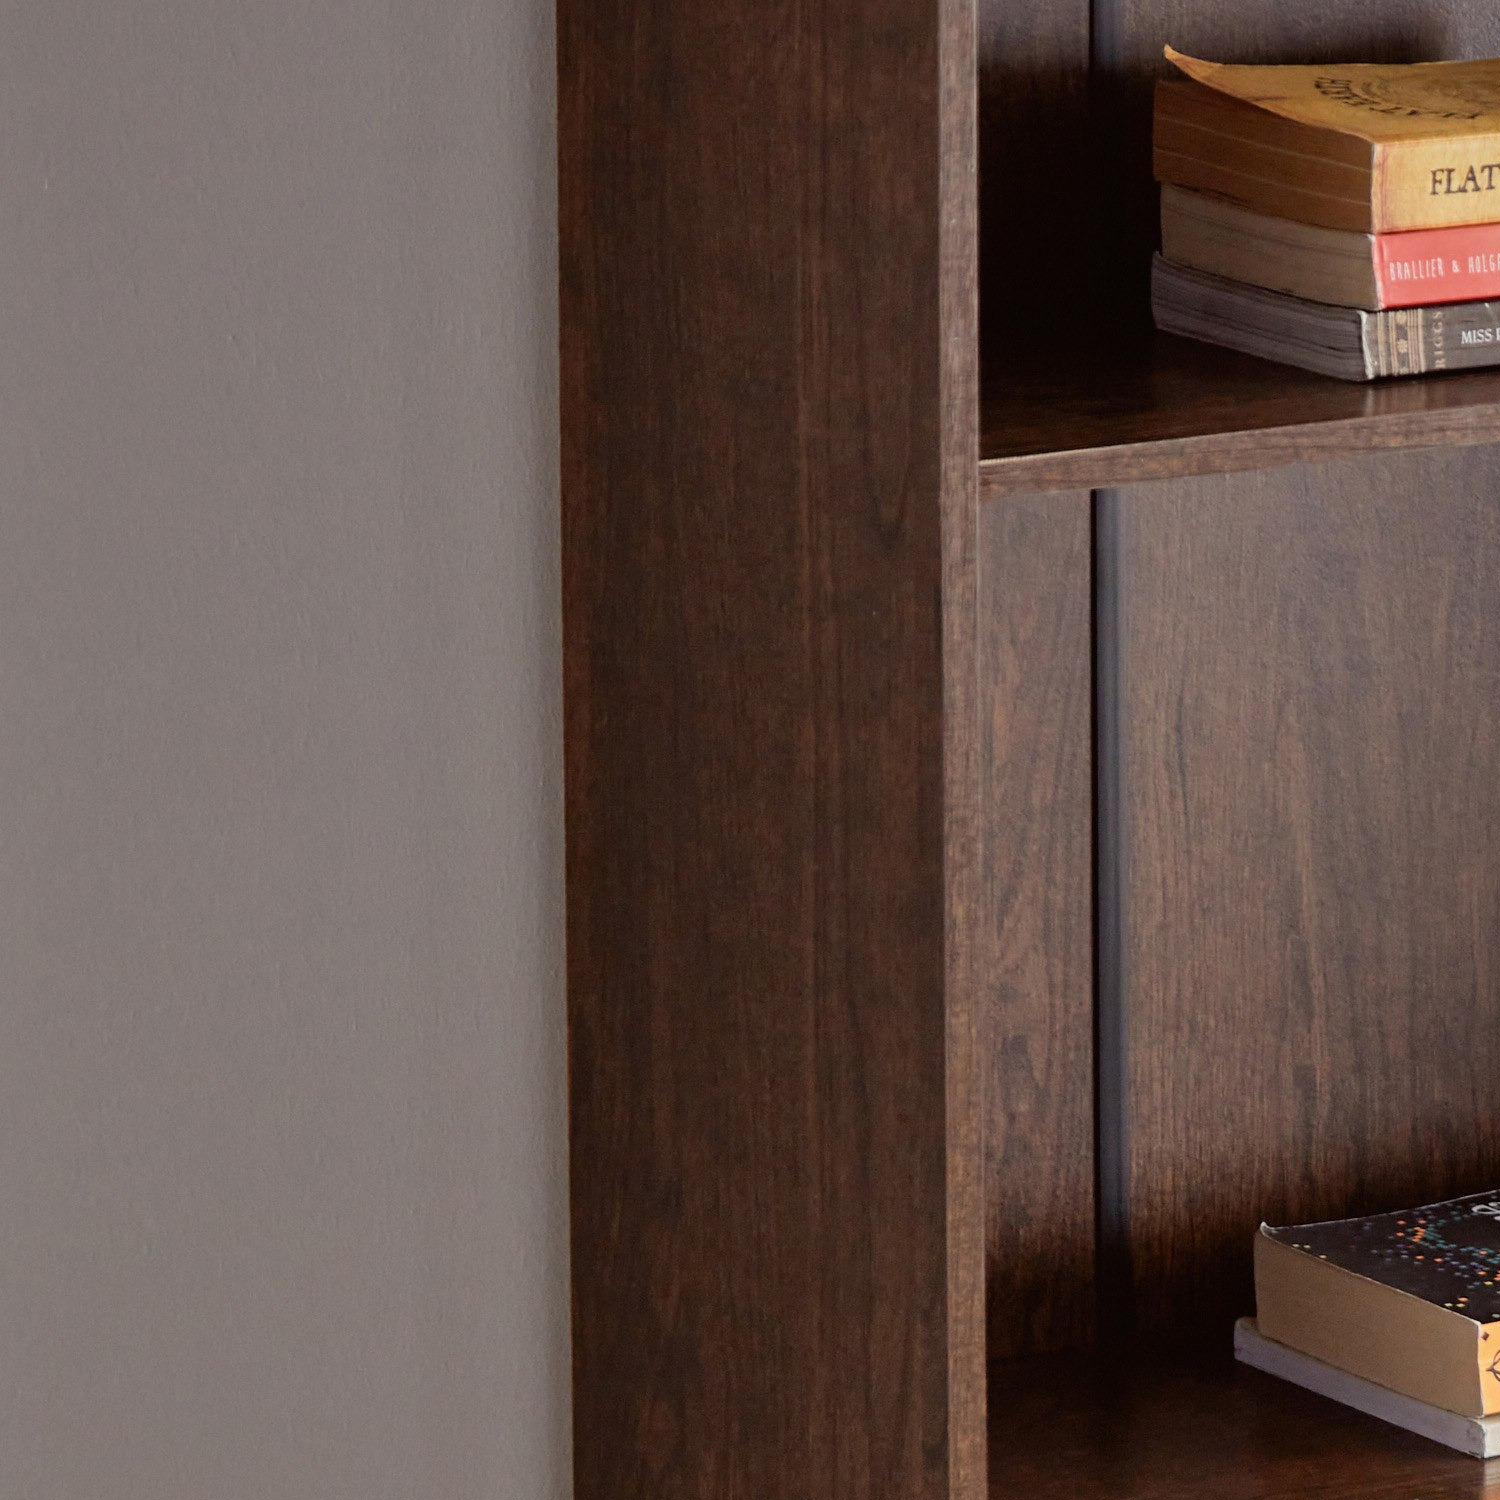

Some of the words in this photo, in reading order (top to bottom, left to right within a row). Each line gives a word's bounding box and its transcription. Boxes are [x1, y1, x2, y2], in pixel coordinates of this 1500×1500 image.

[1389, 257, 1444, 281] BRALLIER
[1432, 311, 1446, 369] RIGGS
[1461, 328, 1493, 345] MISS
